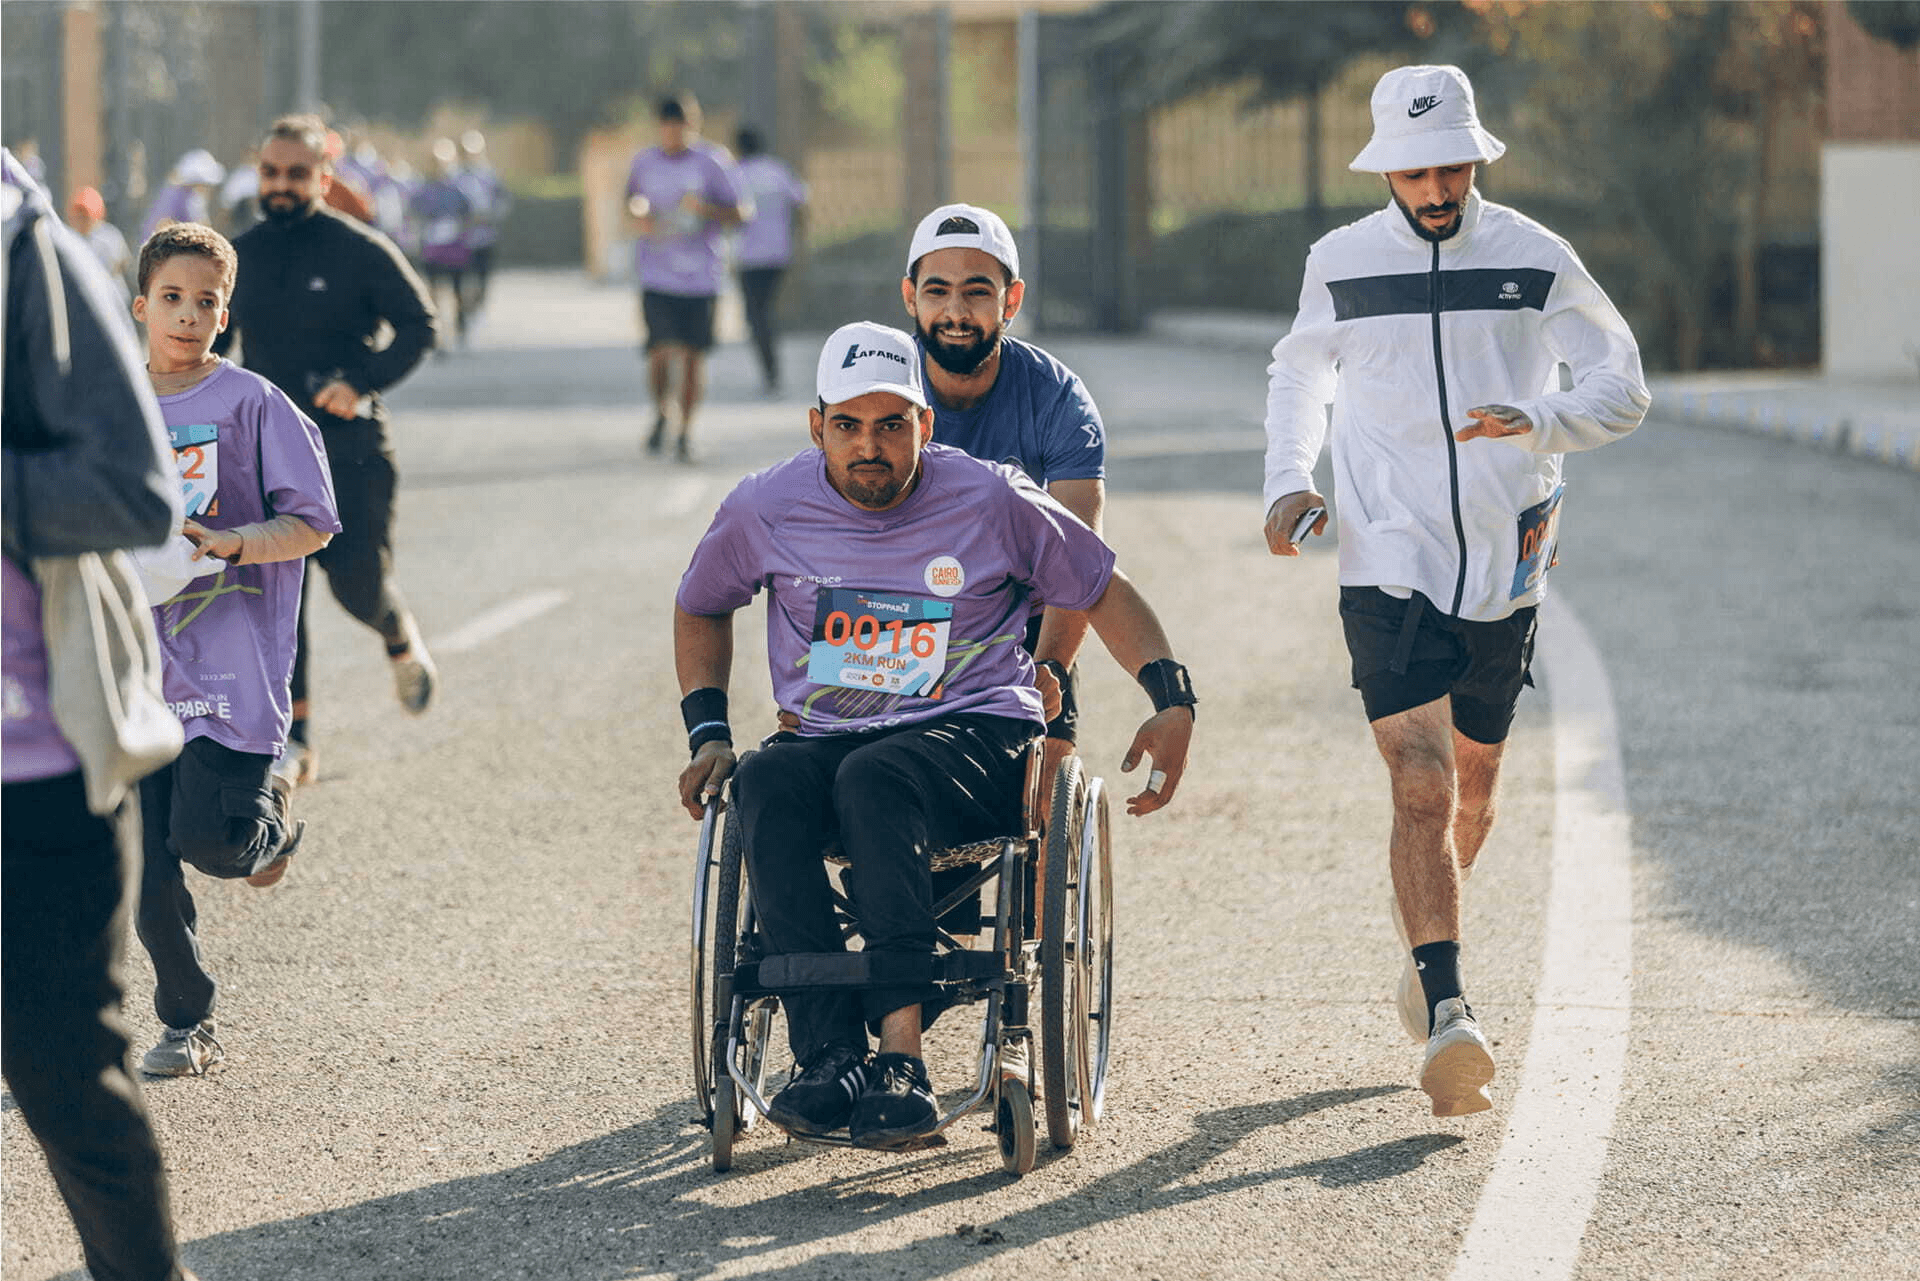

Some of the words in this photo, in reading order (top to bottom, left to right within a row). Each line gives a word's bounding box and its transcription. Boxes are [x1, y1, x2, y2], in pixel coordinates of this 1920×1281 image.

[1412, 95, 1437, 111] NIKE
[845, 346, 908, 367] LAFARGE
[172, 446, 205, 479] 2
[932, 567, 959, 578] CAIRO
[824, 611, 937, 658] 0016
[842, 652, 874, 666] 2KM
[877, 656, 907, 670] RUN
